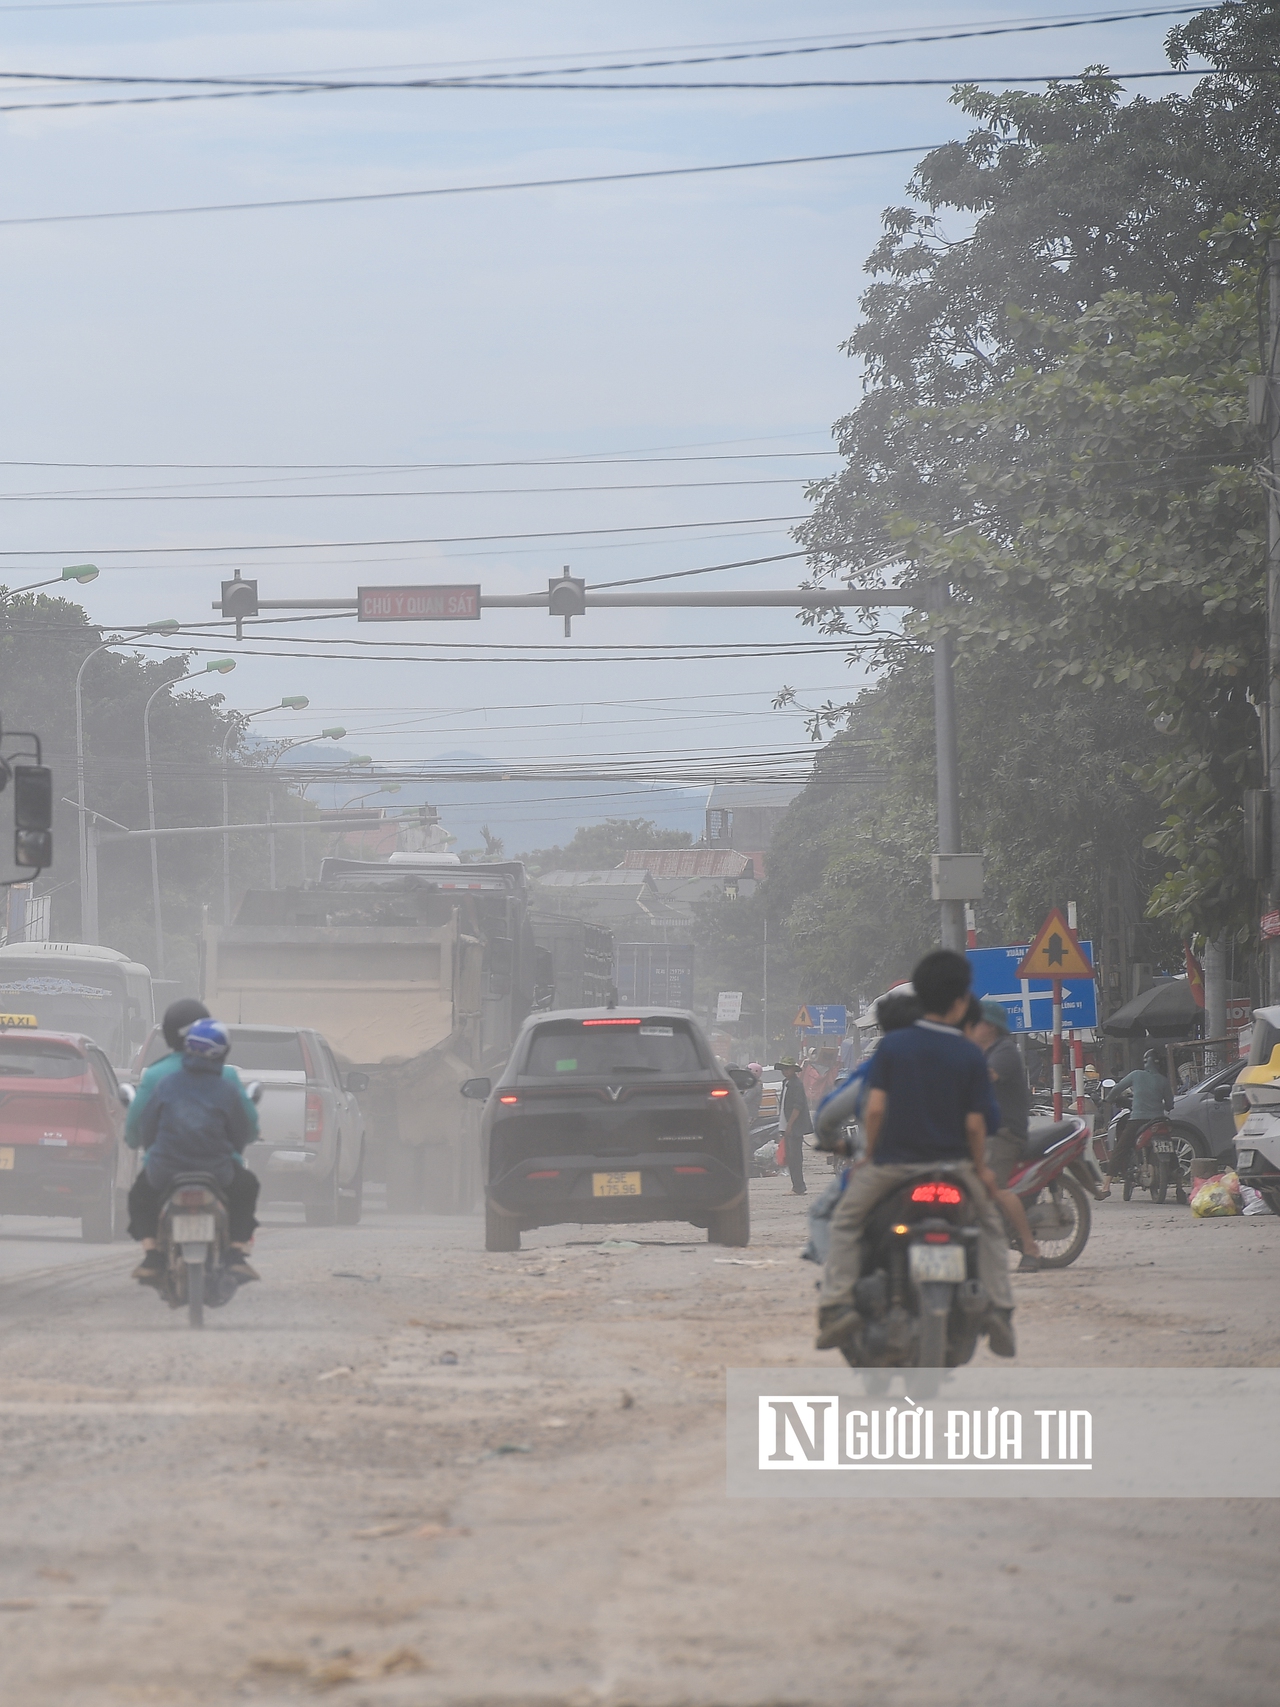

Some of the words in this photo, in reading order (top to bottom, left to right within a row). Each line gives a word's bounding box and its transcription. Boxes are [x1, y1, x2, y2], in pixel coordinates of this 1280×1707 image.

[364, 593, 391, 615] CHÚ
[395, 592, 405, 614] Ý
[407, 597, 445, 614] QUAN
[448, 591, 475, 613] SÁT
